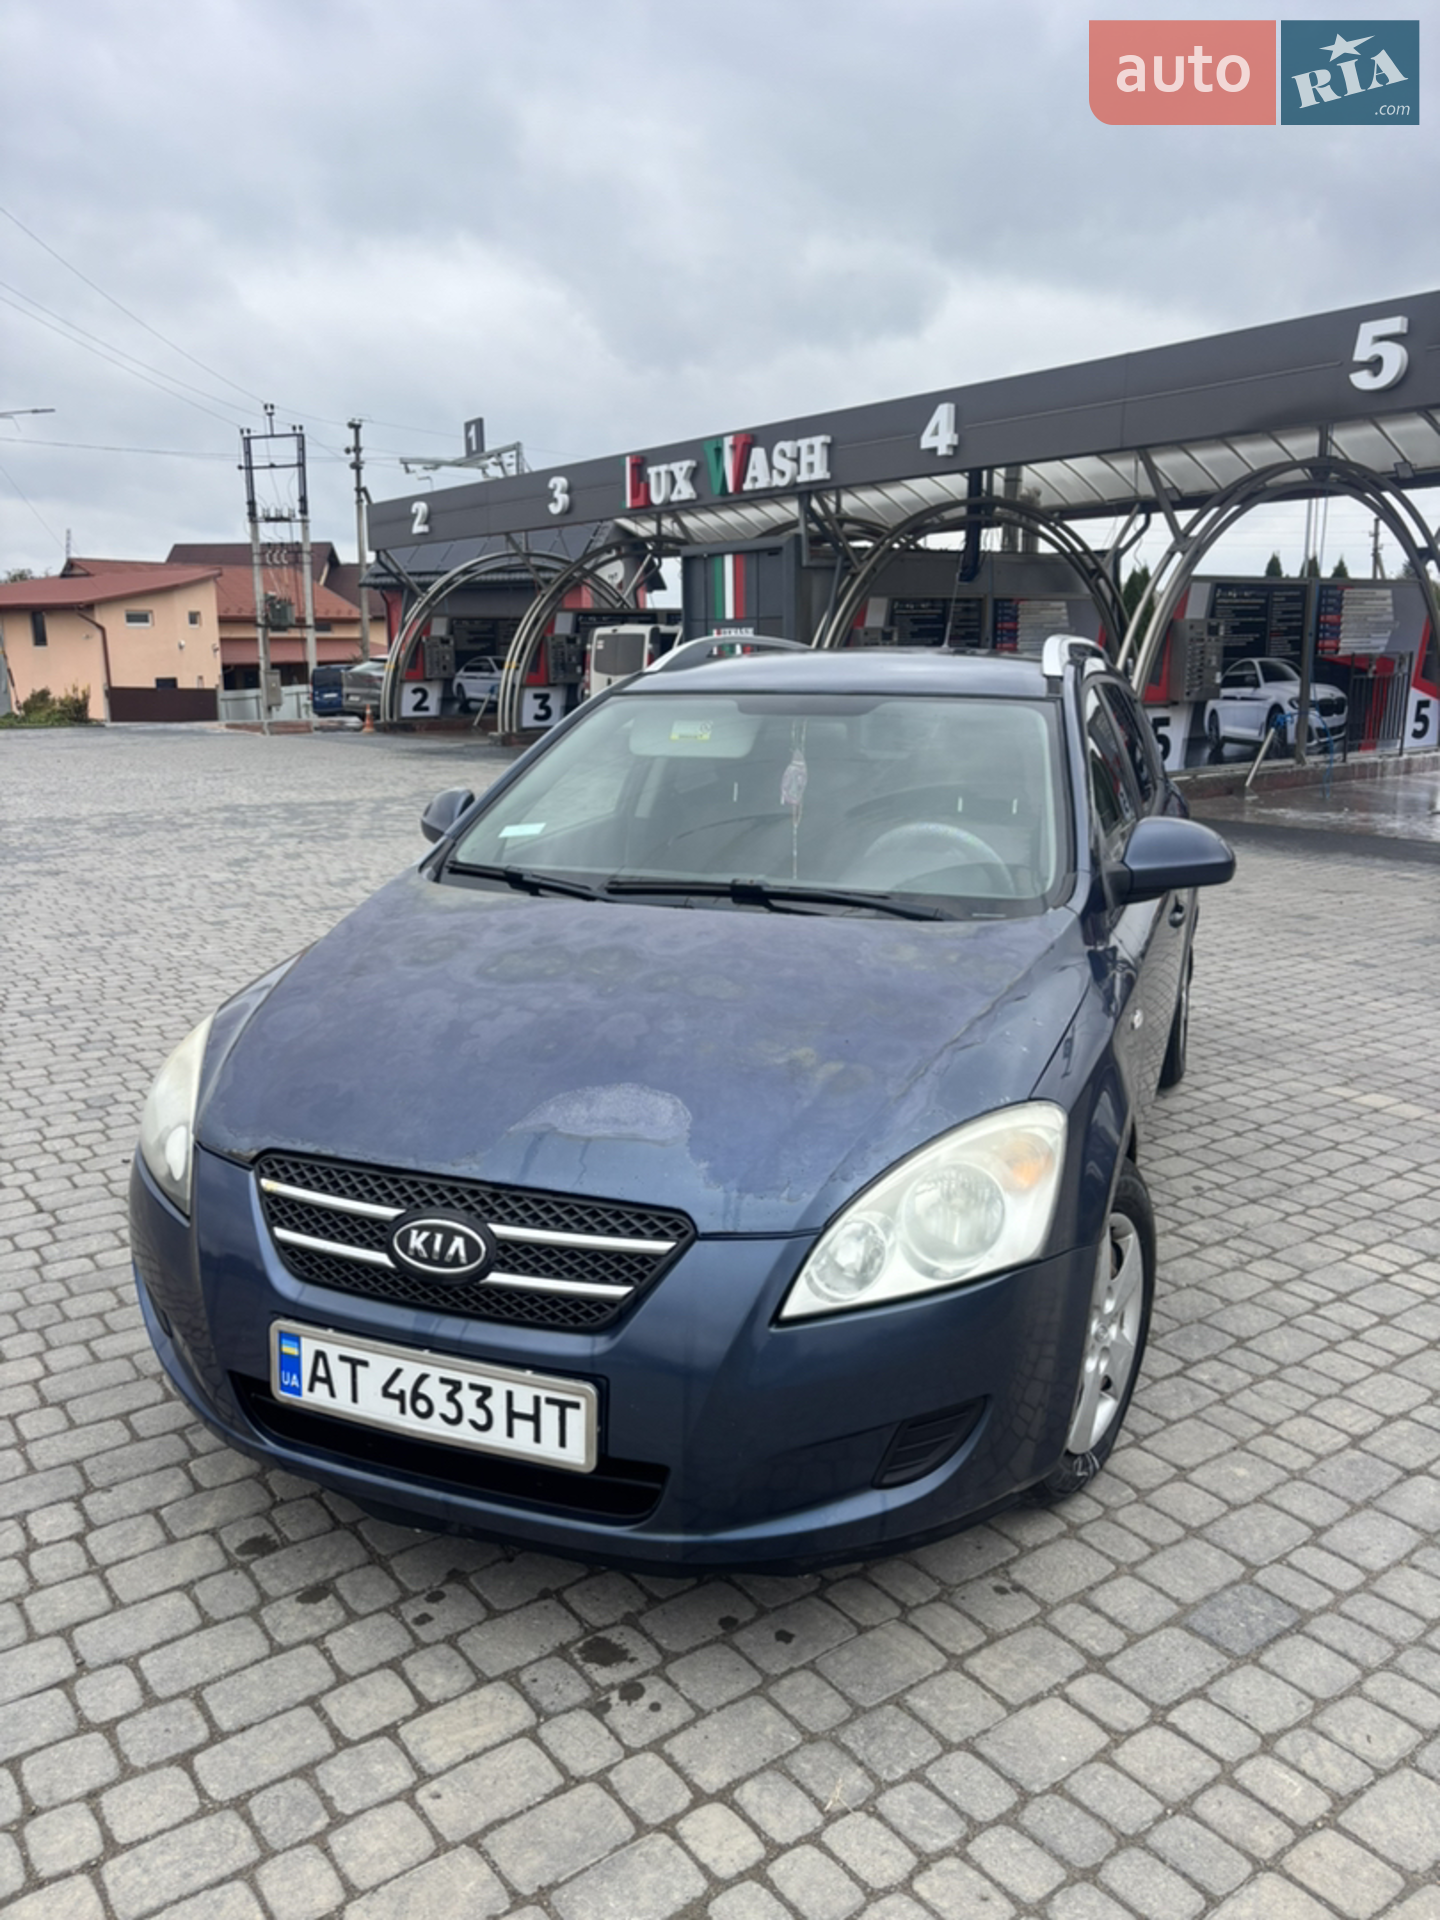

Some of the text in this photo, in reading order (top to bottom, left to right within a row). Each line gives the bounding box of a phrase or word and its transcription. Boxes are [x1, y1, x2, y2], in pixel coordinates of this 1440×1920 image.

[1348, 316, 1409, 391] 5
[467, 424, 477, 453] 1
[919, 402, 958, 456] 4
[548, 477, 570, 514] 3
[411, 501, 430, 534] 2
[411, 687, 430, 712] 2
[533, 694, 553, 721] 3
[1411, 700, 1431, 739] 5
[408, 1229, 467, 1264] KIA
[281, 1370, 299, 1388] UA
[307, 1349, 581, 1449] AT 4633 HT
